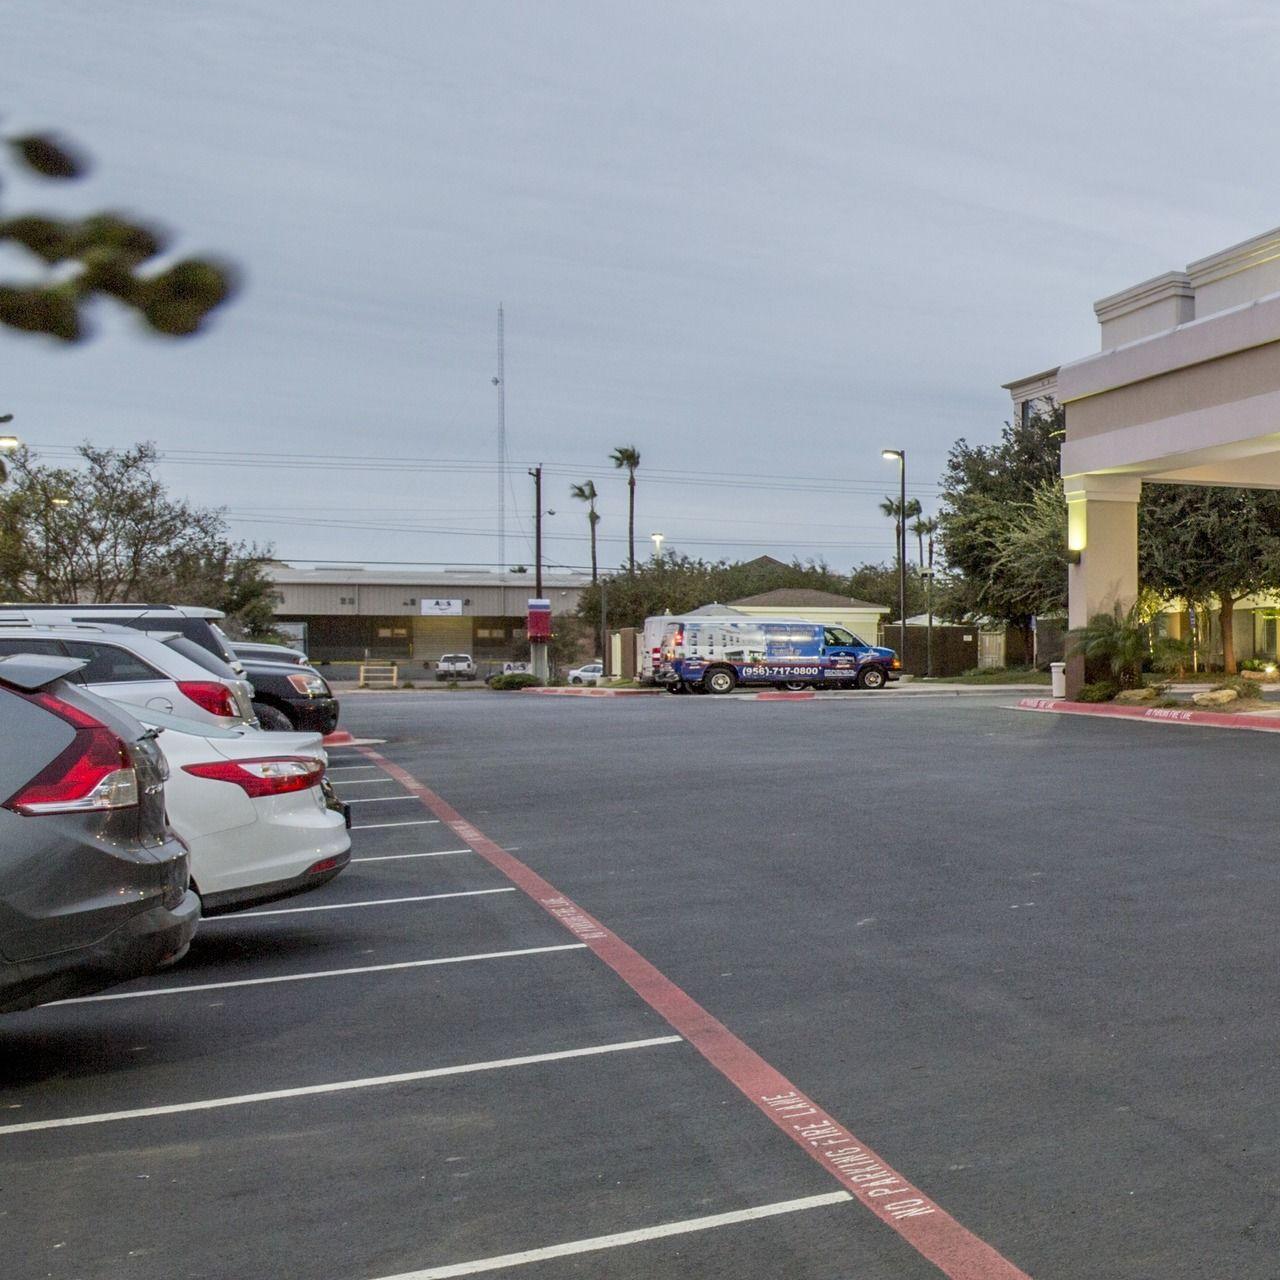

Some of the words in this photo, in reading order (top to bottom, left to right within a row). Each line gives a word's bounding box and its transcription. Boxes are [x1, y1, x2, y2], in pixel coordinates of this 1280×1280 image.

[761, 1091, 817, 1119] LANE
[793, 1120, 850, 1147] FIRE
[825, 1146, 909, 1197] PARKING
[884, 1198, 935, 1220] NO
